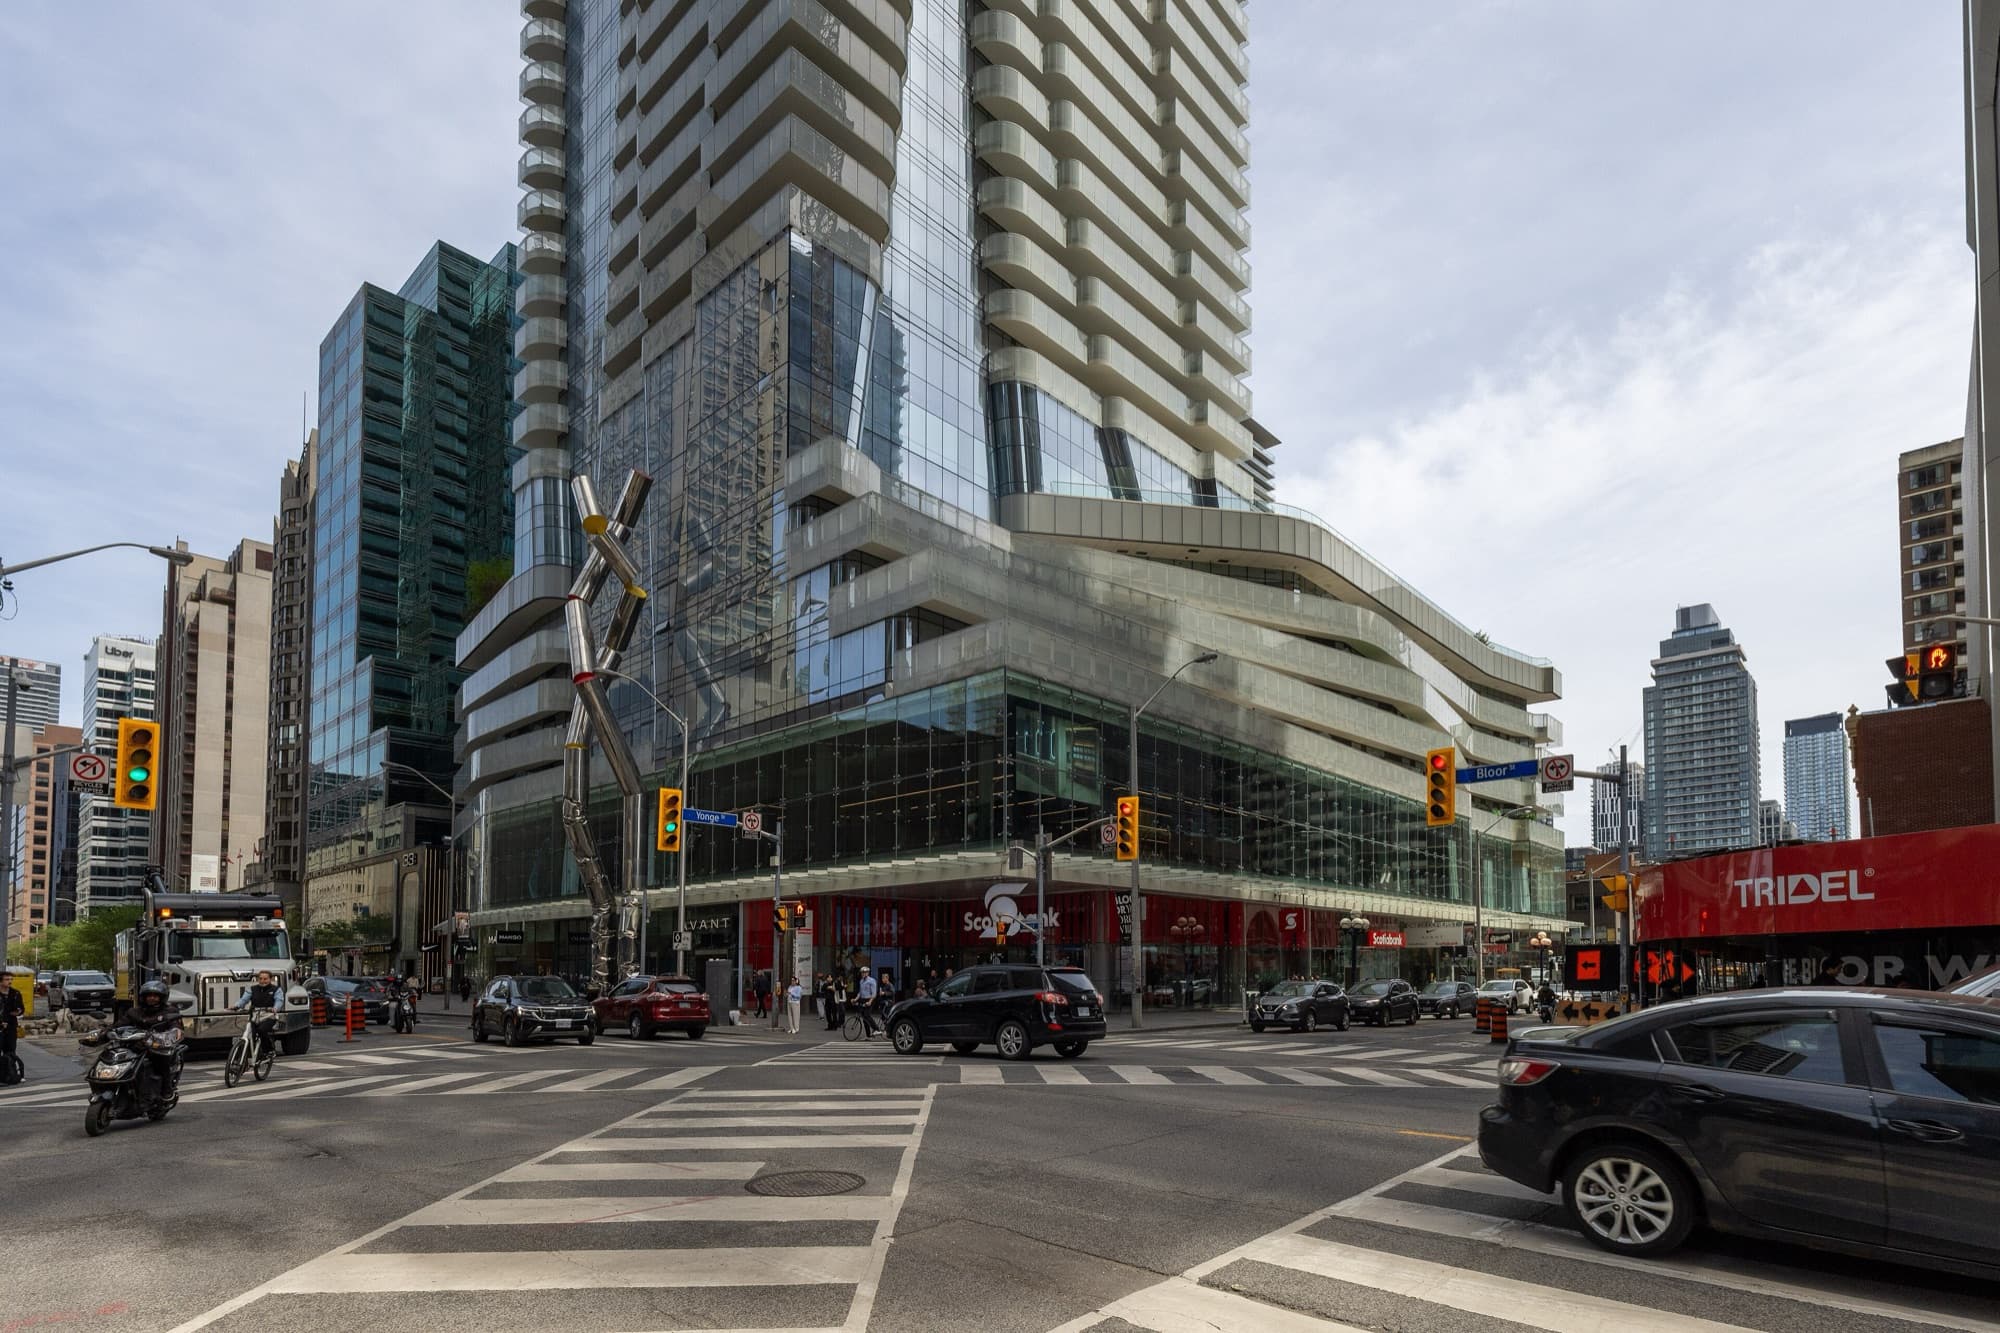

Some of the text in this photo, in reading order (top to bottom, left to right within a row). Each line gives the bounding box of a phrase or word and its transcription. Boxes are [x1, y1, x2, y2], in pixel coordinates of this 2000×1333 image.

[105, 645, 133, 658] Uber
[1476, 767, 1508, 779] Bloor
[695, 811, 720, 823] Yonge
[1734, 869, 1875, 907] TRIDEL
[1373, 933, 1402, 946] Scotiabank
